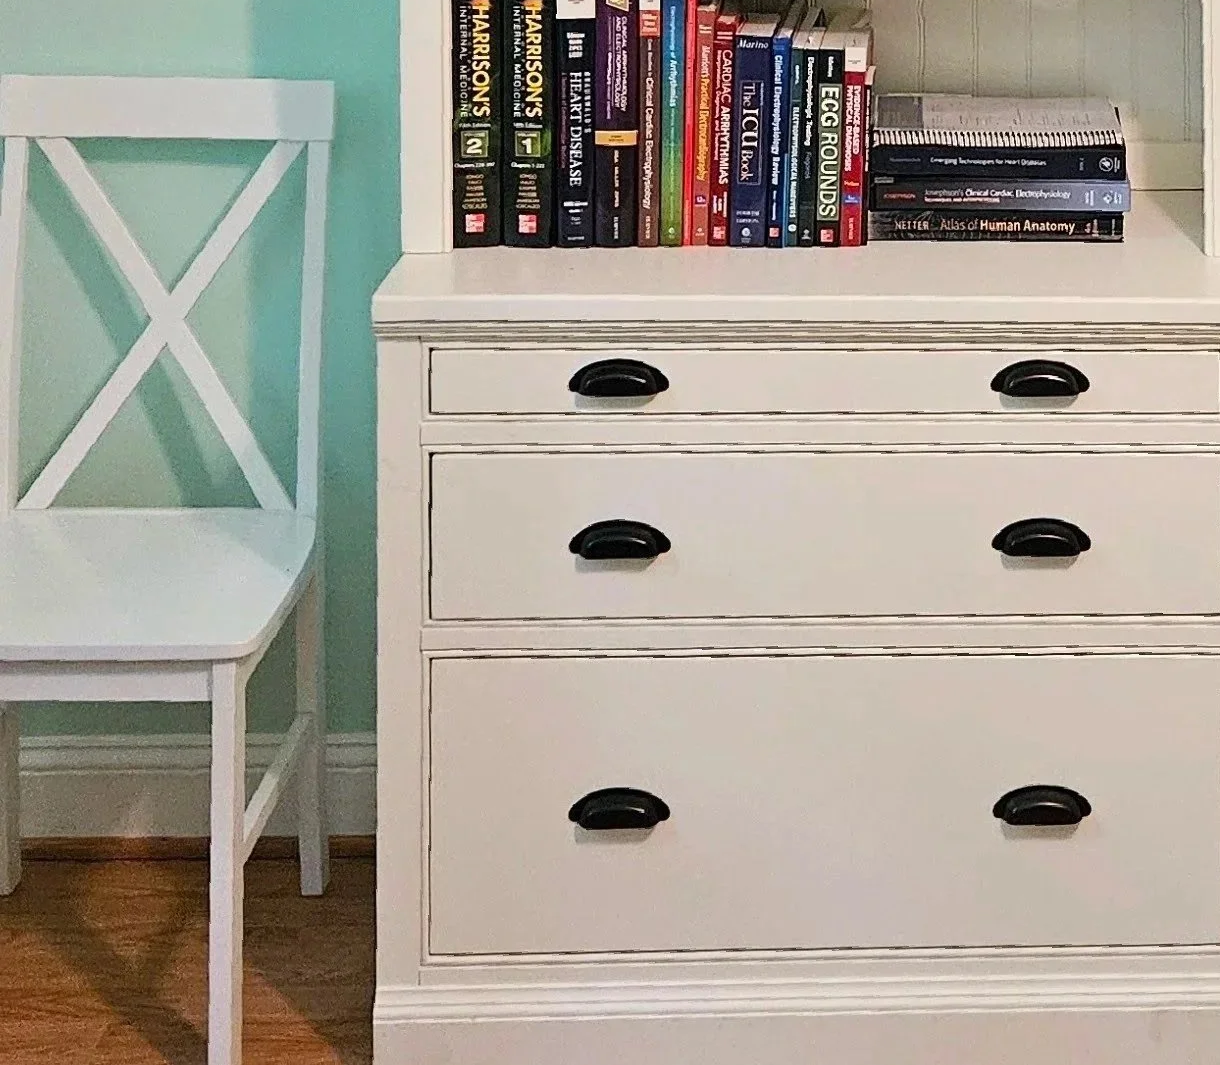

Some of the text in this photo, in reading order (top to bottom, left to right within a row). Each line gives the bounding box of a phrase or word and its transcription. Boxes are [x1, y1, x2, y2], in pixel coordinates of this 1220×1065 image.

[459, 6, 469, 117] INTERNAL MEDICINE
[472, 5, 489, 117] HARRISON'S
[513, 6, 522, 117] INTERNAL MEDICINE
[525, 5, 542, 117] HARRISON'S
[668, 60, 678, 106] Arrhythmias
[737, 37, 769, 49] Marino
[467, 138, 481, 154] 2
[521, 139, 532, 155] 1
[569, 72, 582, 186] HEART DISEASE
[642, 77, 654, 209] Clinical Cardiac Electrophysiology
[719, 50, 732, 184] CARDIAC ARRHYTHMIAS
[740, 83, 758, 181] The ICU Book
[770, 55, 783, 185] Clinical Electrophysiology Review
[818, 87, 839, 217] ECG ROUNDS
[844, 85, 854, 172] PHYSICAL DIAGNOSIS
[853, 85, 861, 155] EVIDENCE-BASED
[895, 219, 1075, 235] NETTER Atlas of Human Anatomy
[965, 189, 1071, 200] Clinical Cardiac Electrophysiology
